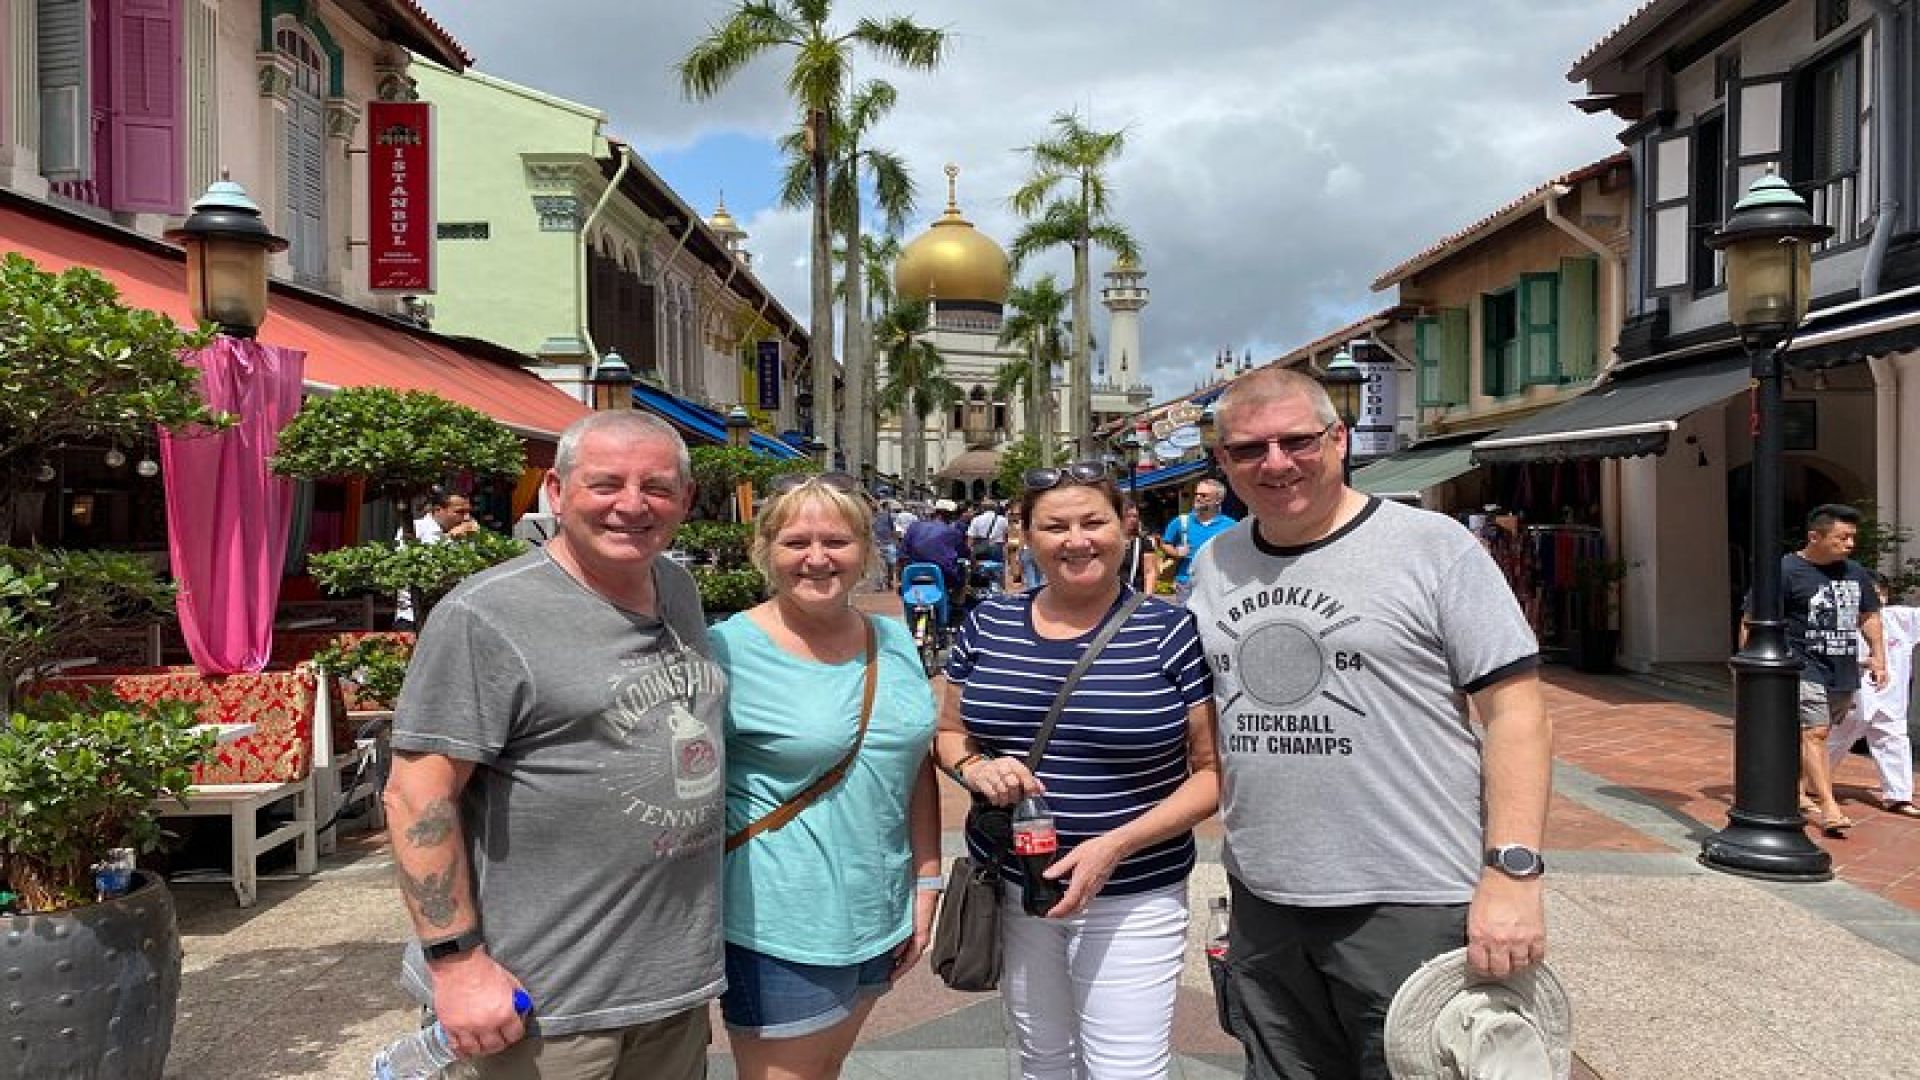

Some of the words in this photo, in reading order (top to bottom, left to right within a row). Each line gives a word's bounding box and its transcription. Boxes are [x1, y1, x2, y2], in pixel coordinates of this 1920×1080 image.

[391, 148, 408, 245] ISTANBUL
[1228, 587, 1345, 622] BROOKLYN
[1335, 651, 1361, 672] 64
[609, 657, 728, 737] MOONSHIN
[1237, 714, 1336, 733] STICKBALL
[1229, 736, 1259, 753] CITY
[1269, 738, 1353, 756] CHAMPS
